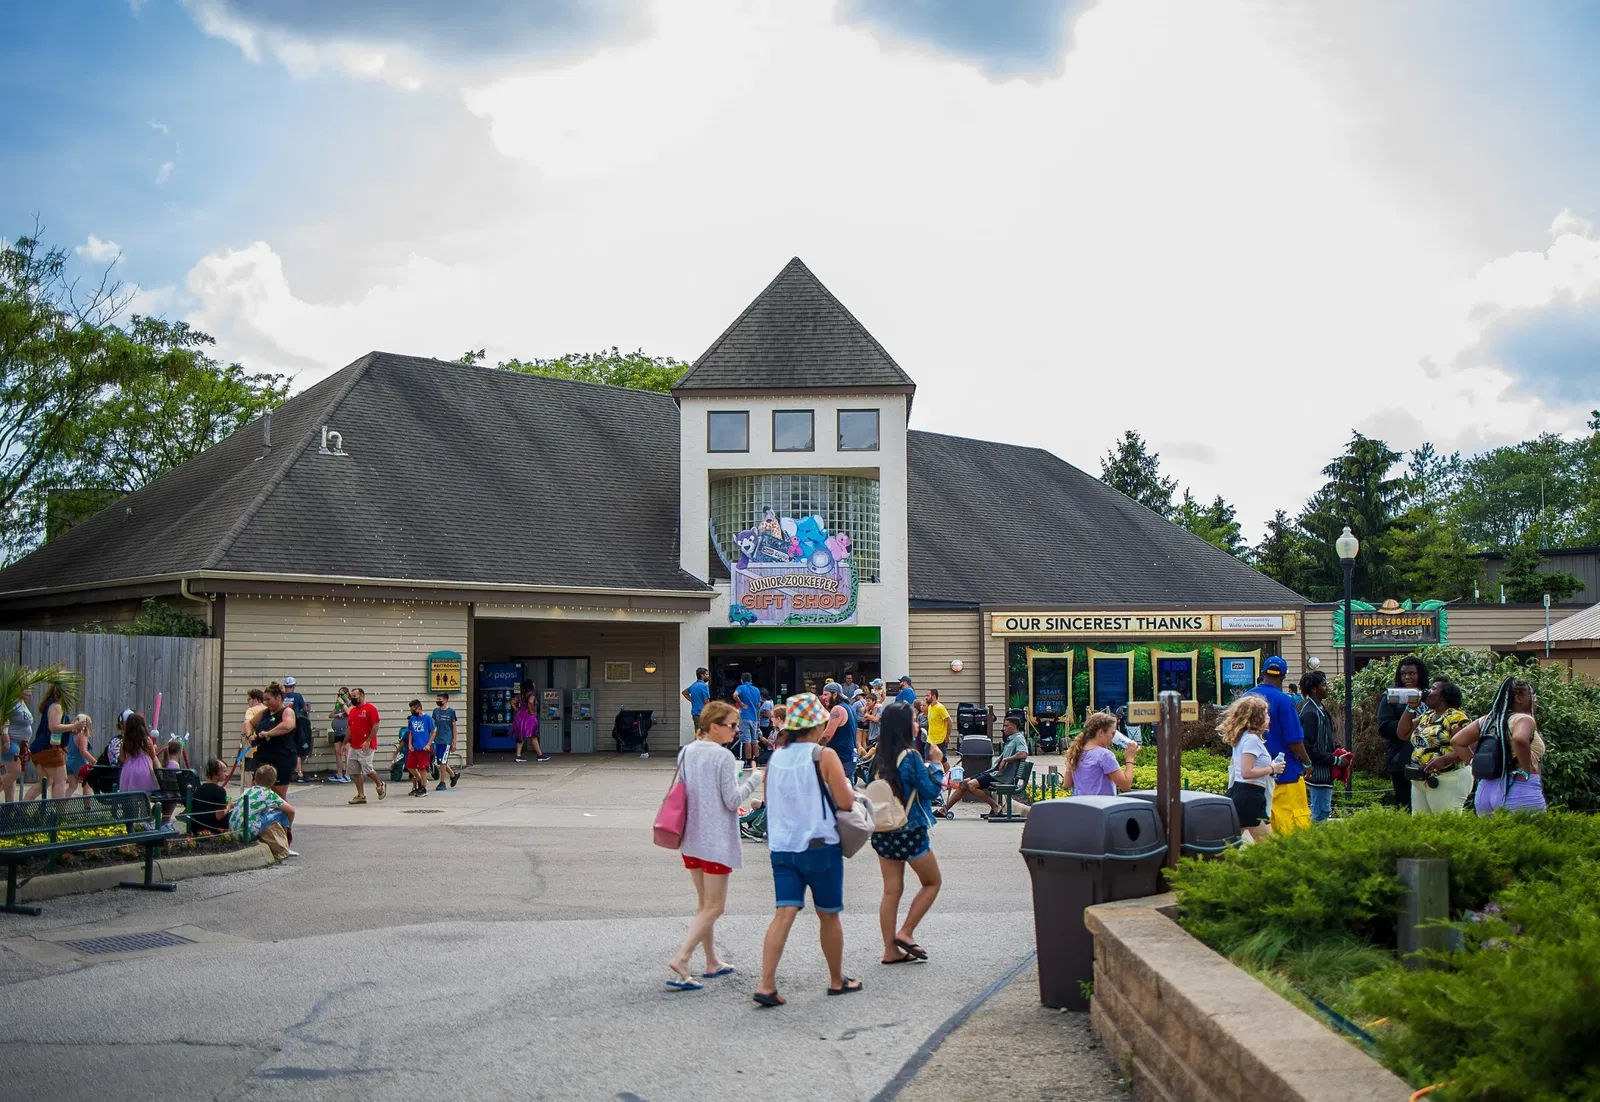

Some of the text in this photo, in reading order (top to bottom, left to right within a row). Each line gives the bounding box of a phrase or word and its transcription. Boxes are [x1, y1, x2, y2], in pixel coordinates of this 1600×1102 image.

[750, 576, 838, 592] JUNIOR ZOOKEEPER
[742, 594, 848, 610] GIFT SHOP
[1005, 617, 1202, 630] OUR SINCEREST THANKS
[494, 671, 517, 680] pepsi
